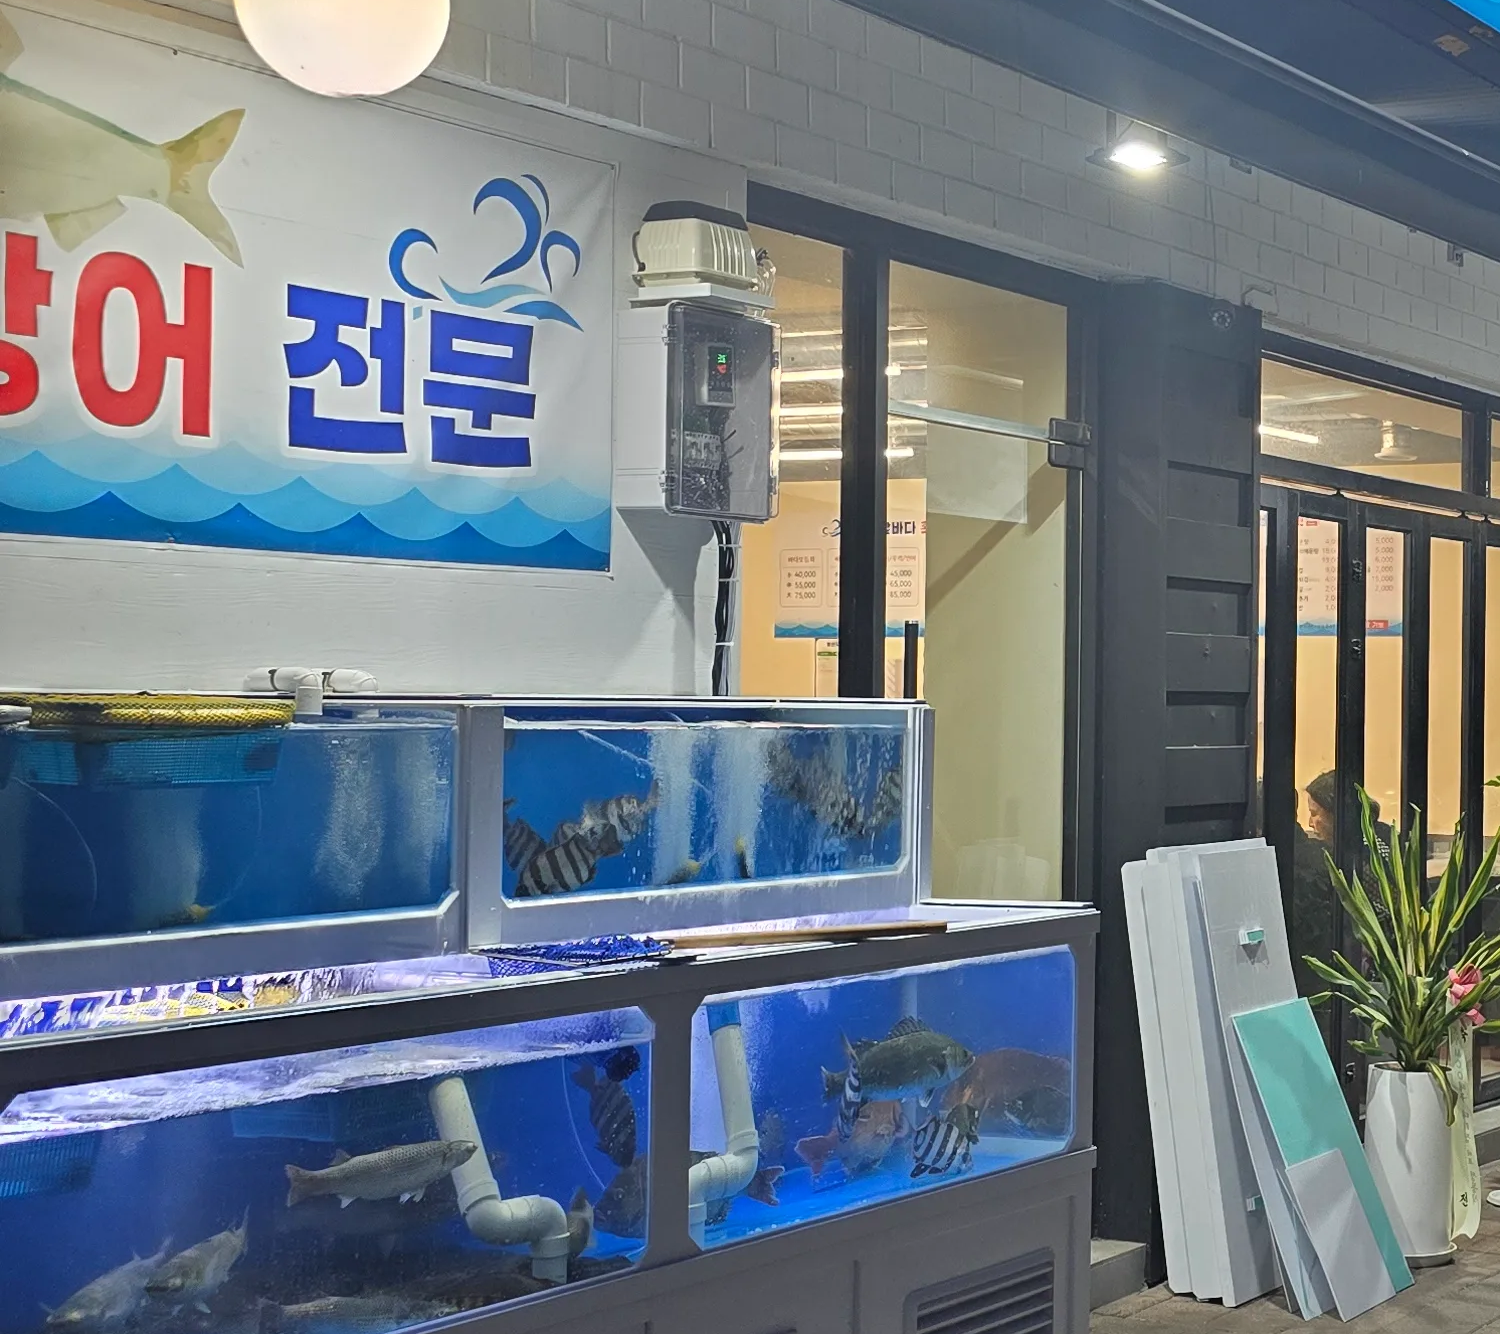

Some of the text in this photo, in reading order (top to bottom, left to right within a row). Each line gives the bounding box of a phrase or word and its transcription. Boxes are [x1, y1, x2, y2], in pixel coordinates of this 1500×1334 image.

[283, 283, 537, 467] 전문
[794, 570, 816, 579] 40,000
[890, 569, 912, 578] 45,000
[794, 581, 816, 589] 55,000
[794, 591, 816, 599] 75,000
